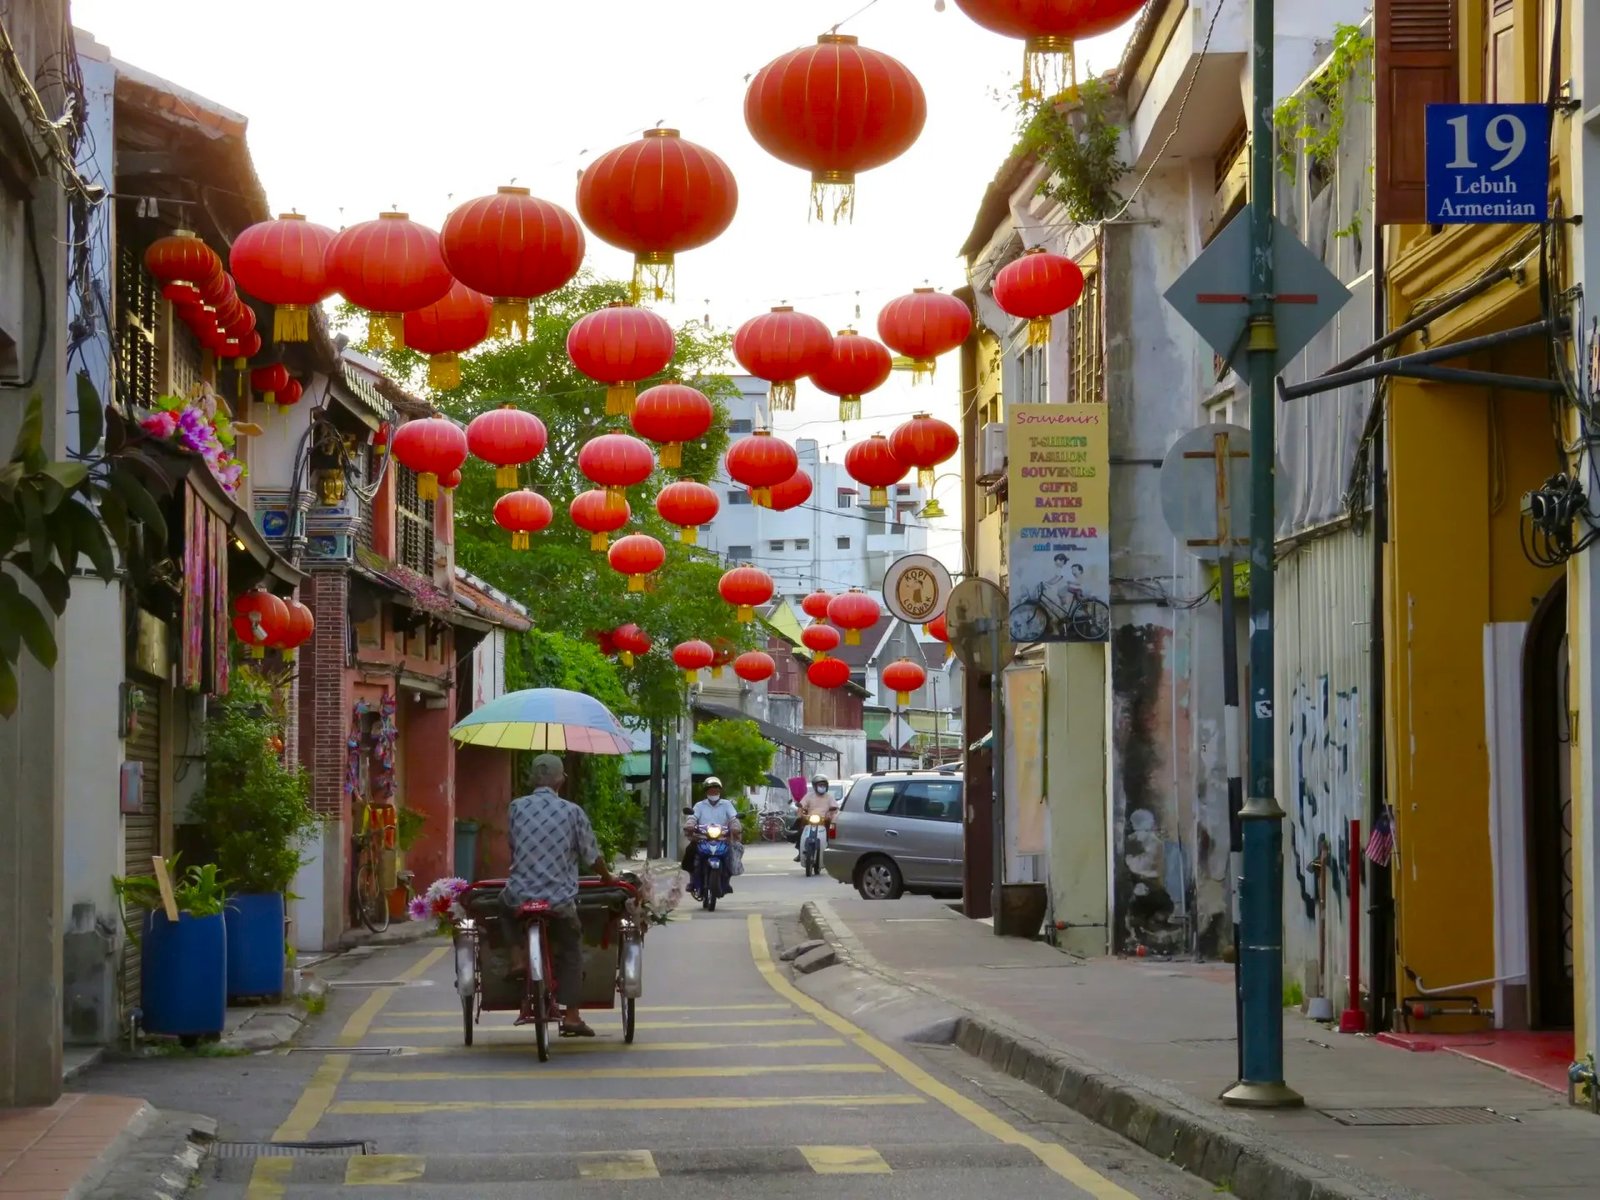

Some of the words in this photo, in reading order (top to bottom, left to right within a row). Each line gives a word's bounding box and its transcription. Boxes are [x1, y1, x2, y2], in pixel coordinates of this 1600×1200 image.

[1445, 114, 1527, 172] 19
[1455, 175, 1518, 194] Lebuh
[1437, 197, 1536, 217] Armenian
[1017, 411, 1099, 425] Souvenirs
[1029, 436, 1088, 448] T-SHIRTS
[1030, 451, 1087, 463] FASHION
[1021, 466, 1096, 478] SOUVENIRS
[1039, 482, 1078, 493] GIFTS
[1035, 497, 1082, 508] BATIKS
[1042, 512, 1076, 524] ARTS
[1021, 527, 1098, 539] SWIMWEAR
[905, 570, 928, 582] KOPI
